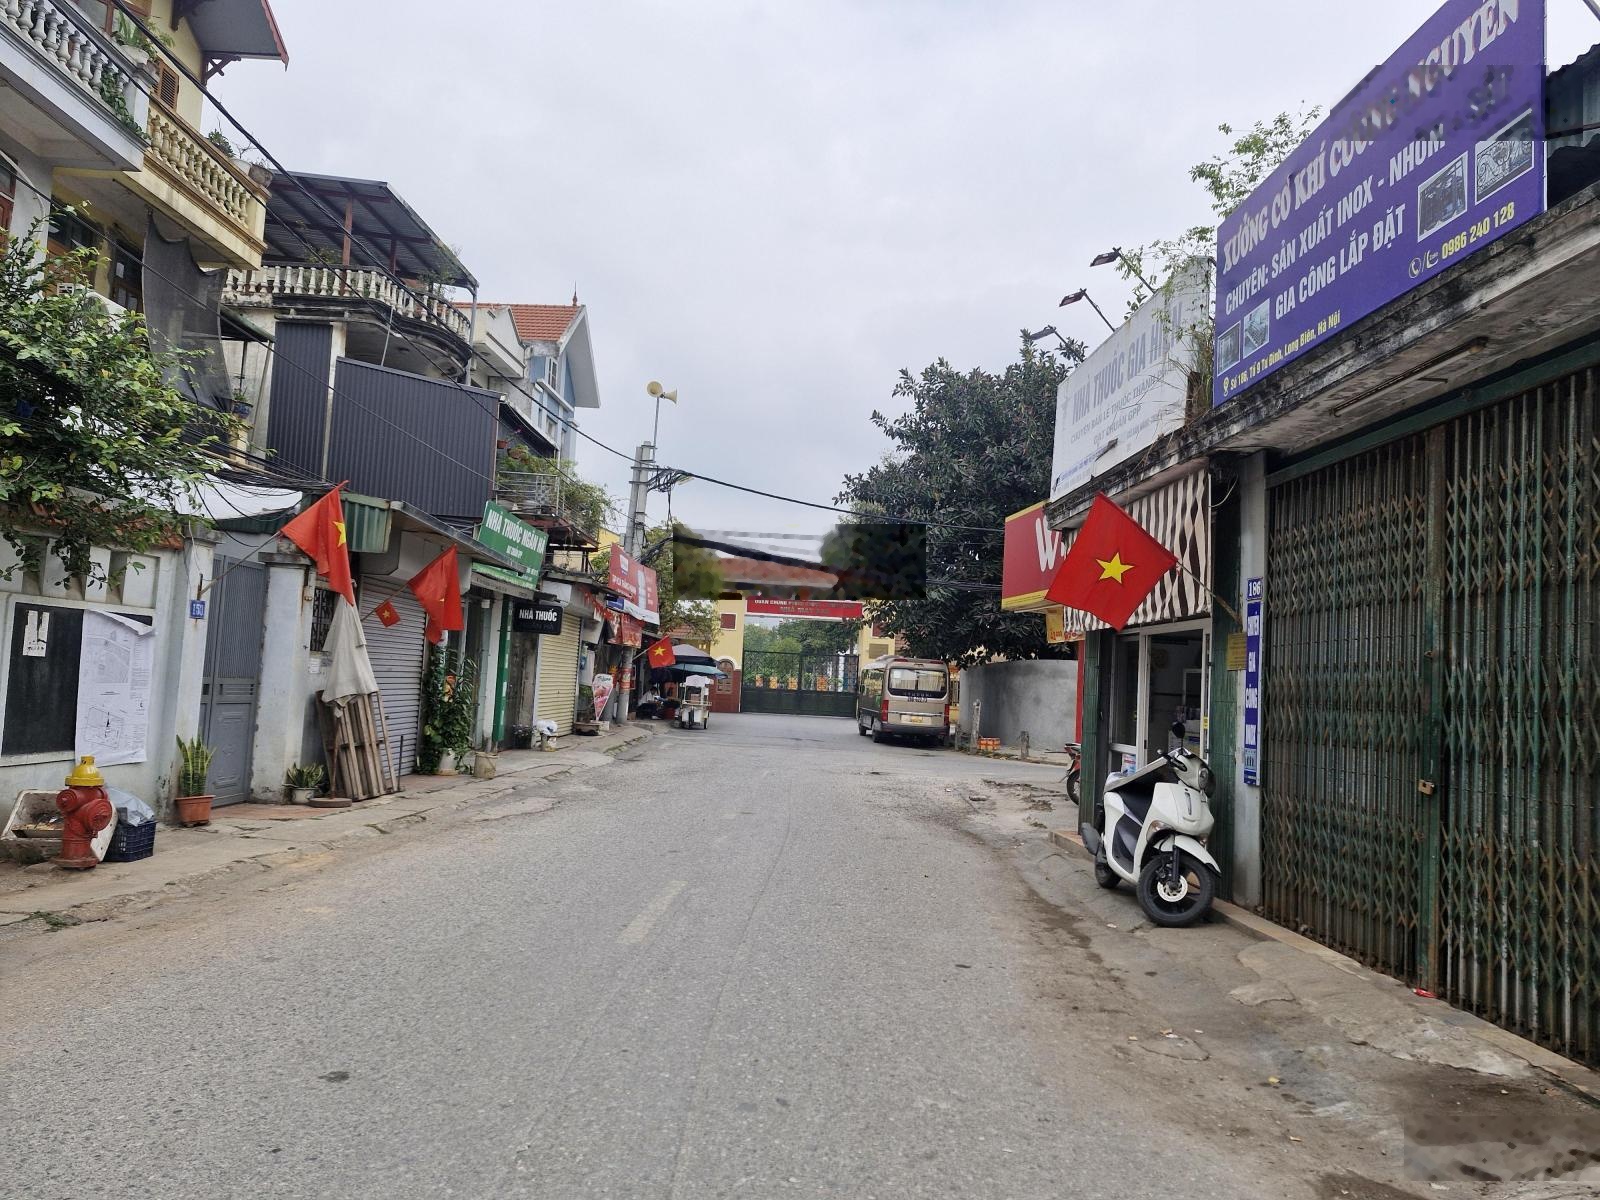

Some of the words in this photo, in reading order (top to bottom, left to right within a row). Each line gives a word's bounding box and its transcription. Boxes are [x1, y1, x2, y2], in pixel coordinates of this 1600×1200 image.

[1294, 141, 1325, 210] KHÍ
[1225, 264, 1269, 316] CHUYÊN:
[1271, 239, 1296, 279] SẢN
[1299, 204, 1334, 258] XUẤT
[1337, 174, 1373, 228] INOX
[1442, 231, 1467, 259] 0986
[1470, 217, 1490, 243] 240
[1493, 201, 1515, 228] 128
[1275, 286, 1296, 320] GIA
[1299, 256, 1336, 303] CÔNG
[1340, 229, 1368, 275] LẮP
[1373, 203, 1406, 249] ĐẶT
[1127, 332, 1146, 381] GIA
[1284, 340, 1299, 356] Long
[1318, 321, 1327, 335] Hà
[1328, 309, 1341, 329] Nội
[519, 608, 534, 620] NHÀ
[535, 608, 558, 622] THUỐC
[1248, 581, 1260, 597] 186
